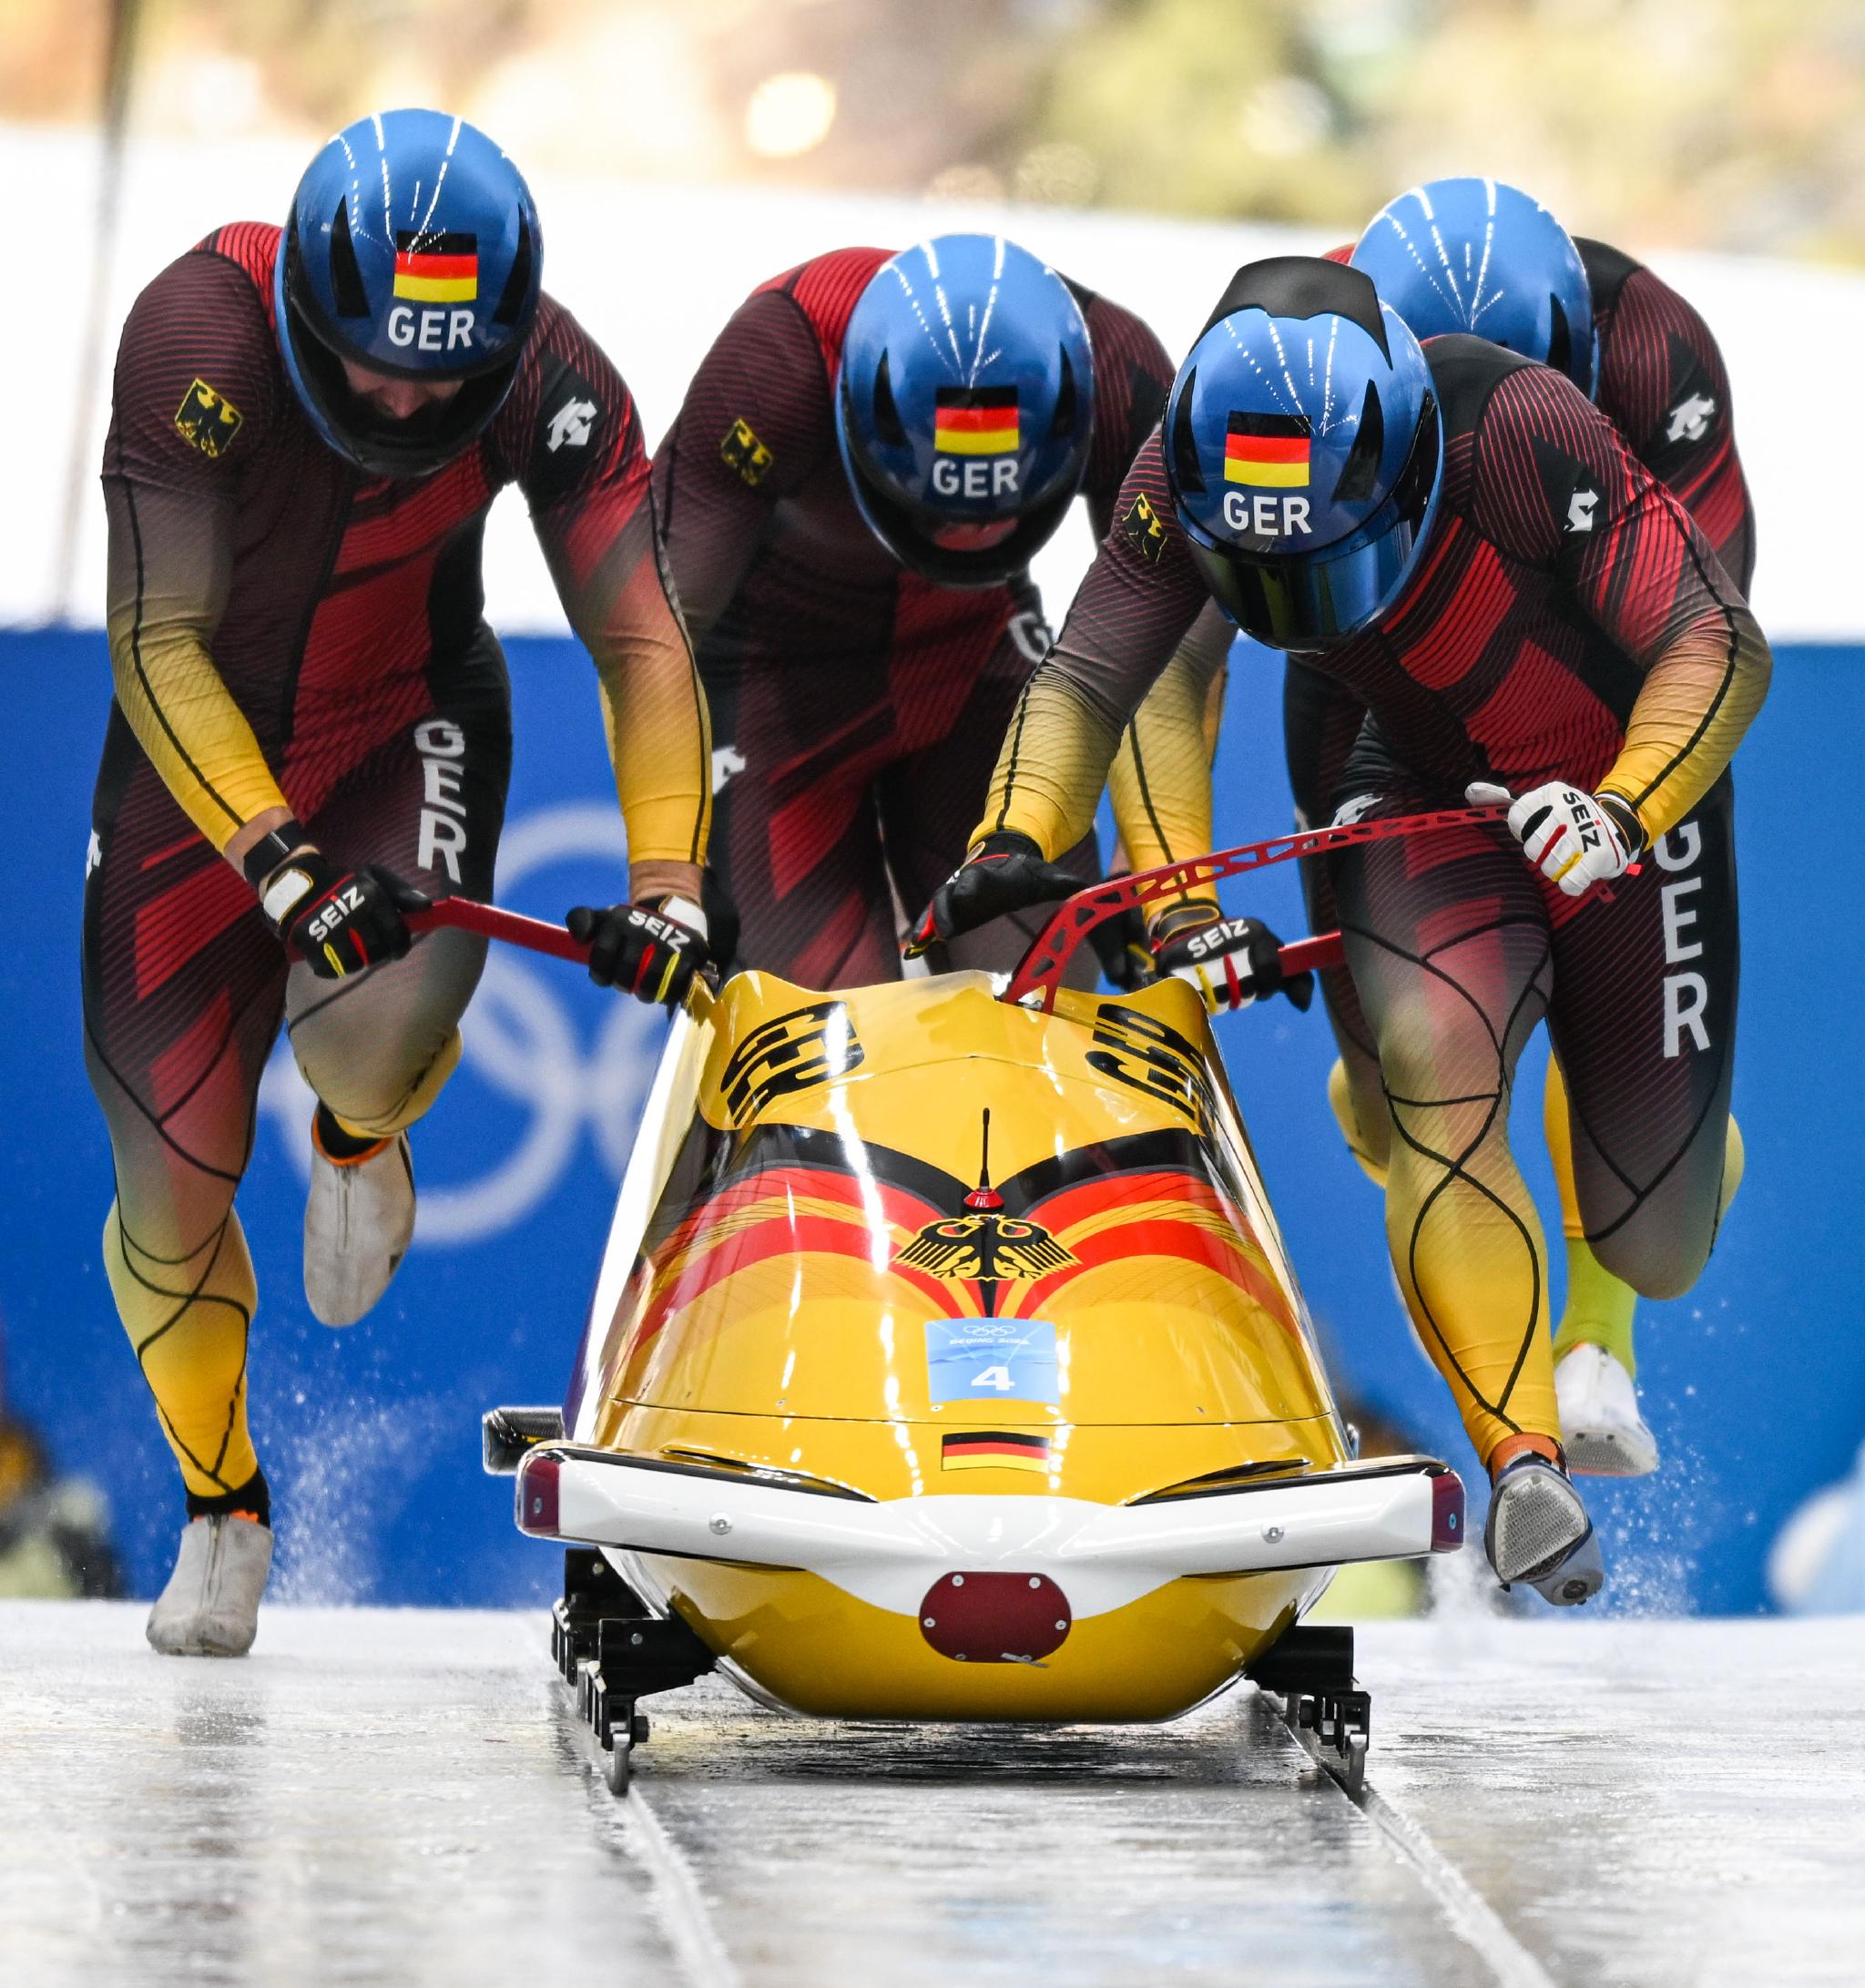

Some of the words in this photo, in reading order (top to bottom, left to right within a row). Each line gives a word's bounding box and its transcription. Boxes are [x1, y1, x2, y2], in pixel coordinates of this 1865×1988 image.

[388, 306, 474, 351] GER
[932, 459, 1019, 497] GER
[1223, 491, 1312, 535] GER
[414, 719, 467, 884] GER
[1563, 791, 1601, 853] SEIZ
[309, 884, 365, 942] SEIZ
[627, 910, 691, 953] SEIZ
[1187, 918, 1249, 958] SEIZ
[949, 1337, 994, 1346] BEIJING
[970, 1365, 1016, 1391] 4
